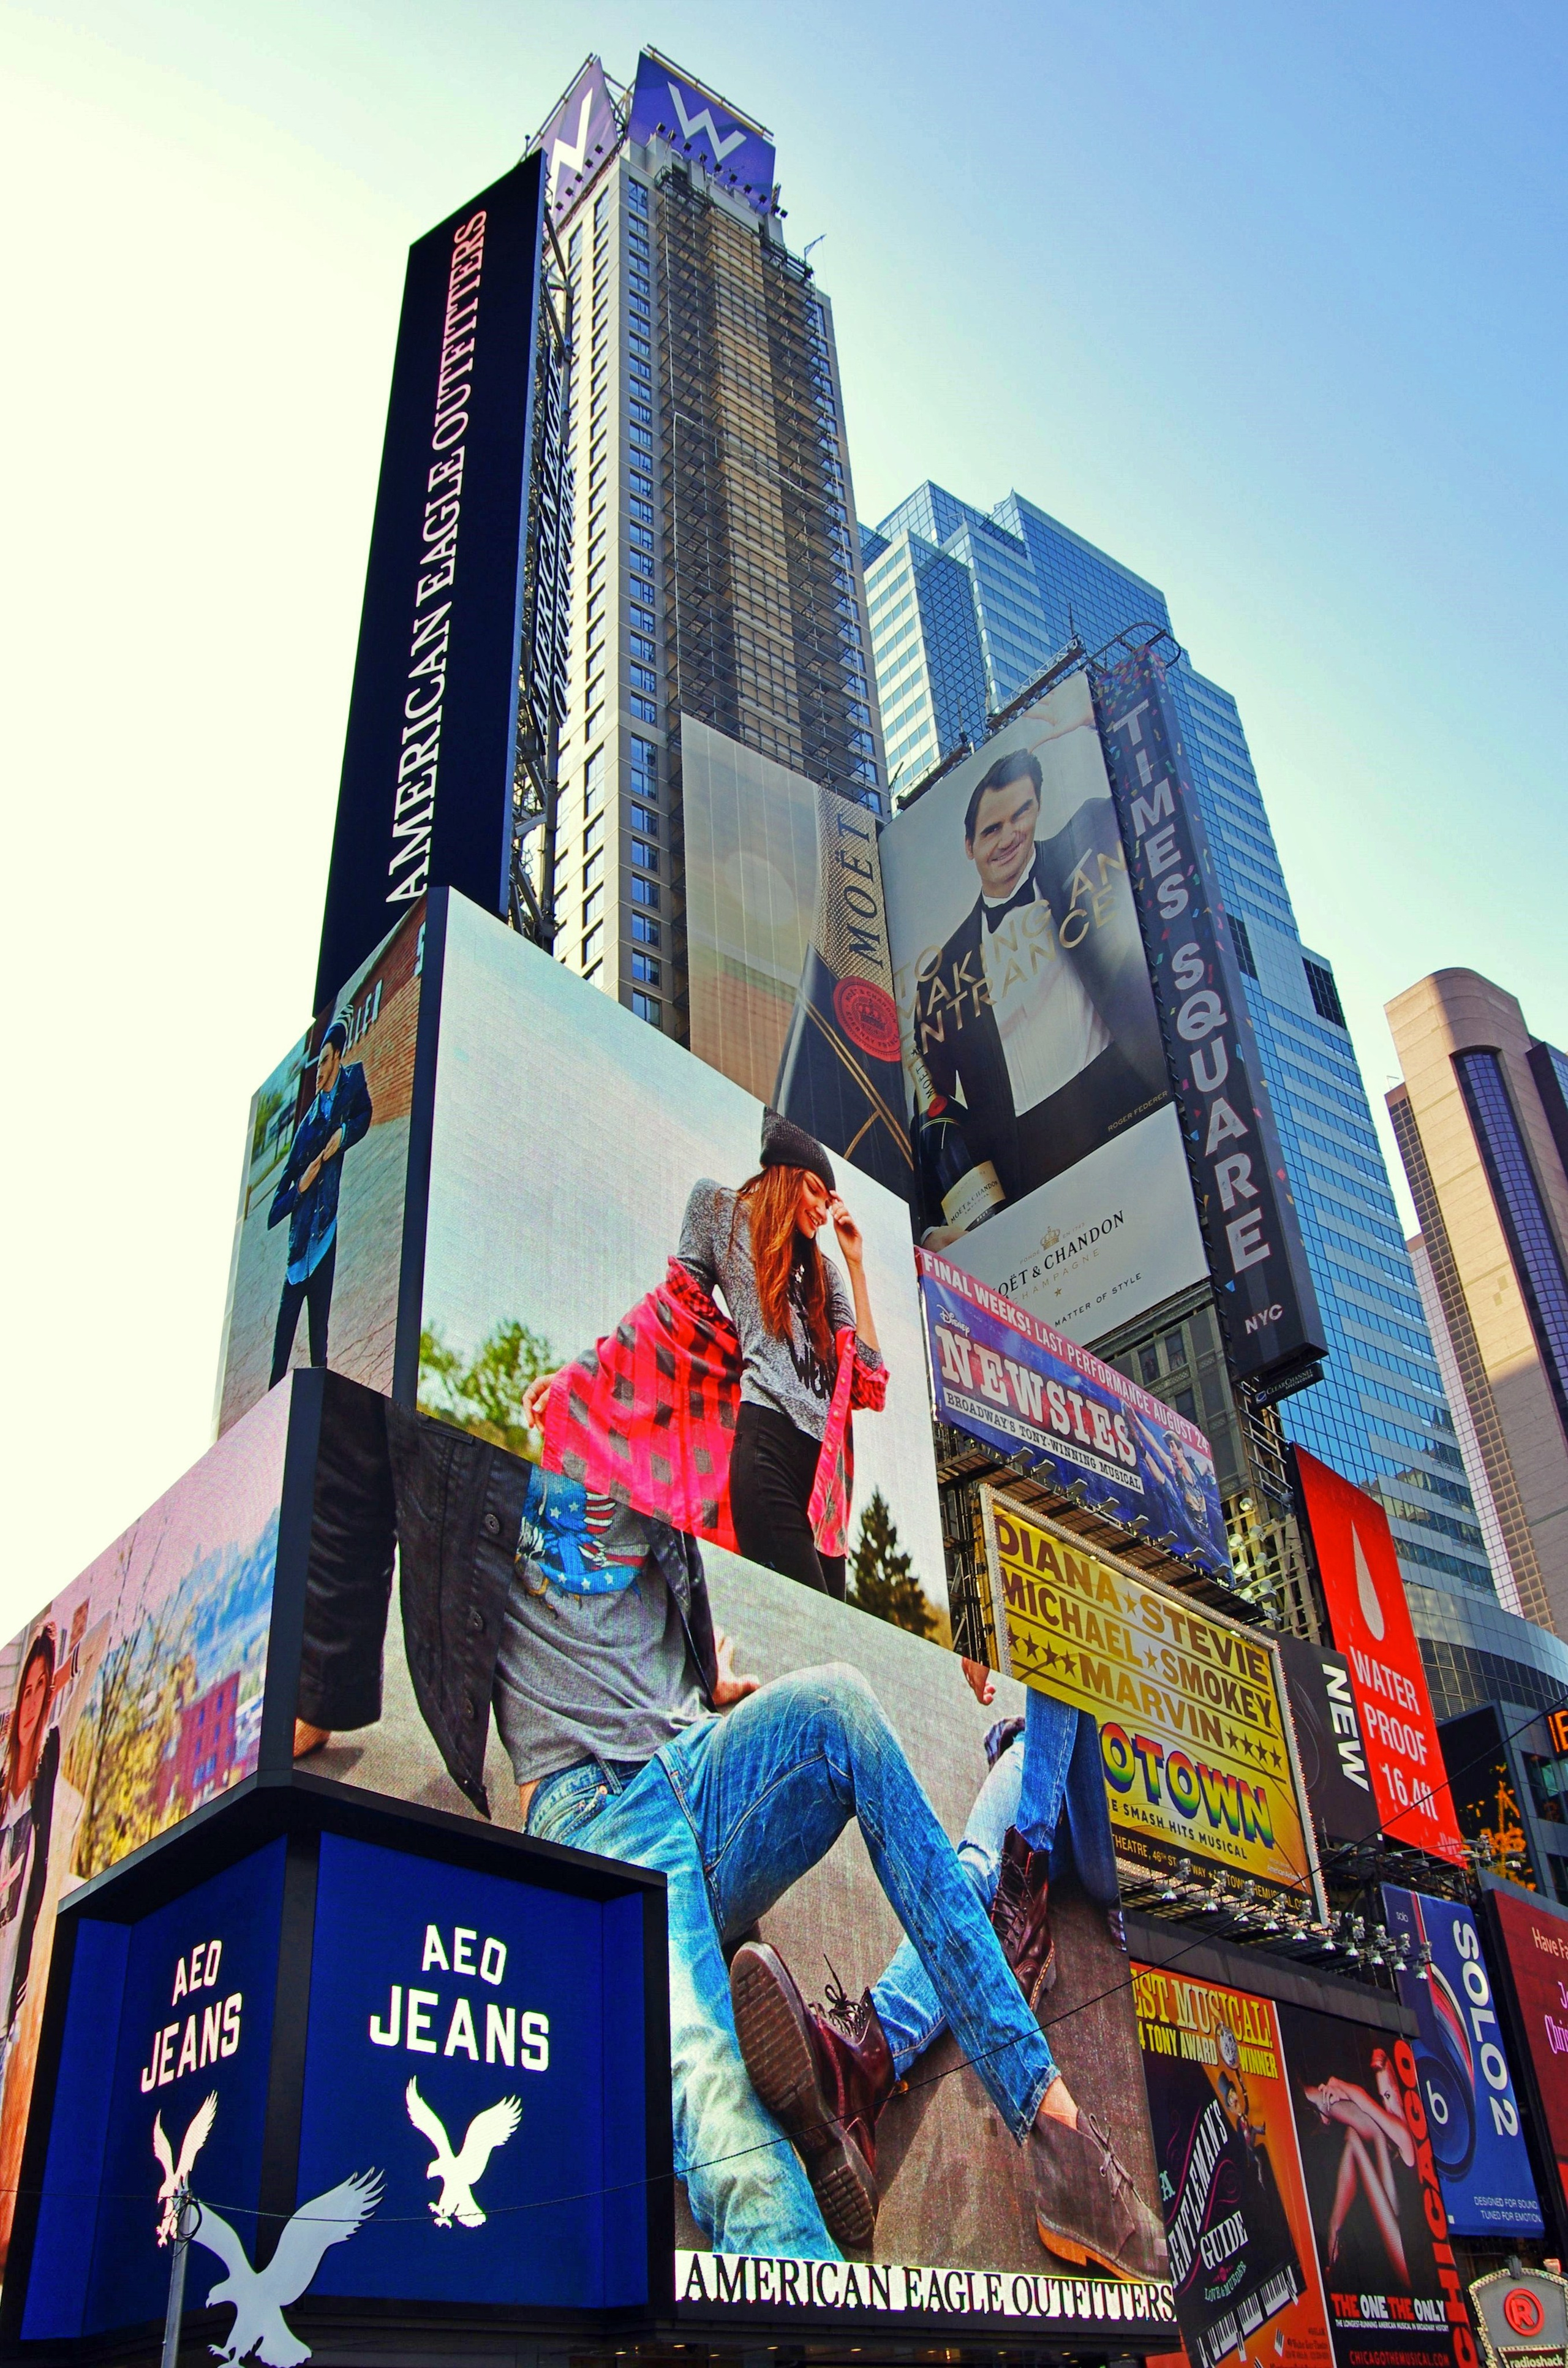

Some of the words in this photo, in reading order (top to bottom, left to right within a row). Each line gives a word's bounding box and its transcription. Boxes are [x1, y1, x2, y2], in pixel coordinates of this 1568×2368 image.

[667, 81, 747, 162] W
[431, 210, 487, 451] OUTFITTERS
[415, 445, 466, 608] EAGLE
[385, 601, 452, 904] AMERICAN
[837, 813, 884, 969] MOËT
[1069, 840, 1127, 910] AN
[892, 944, 943, 999] TO
[1113, 698, 1188, 920] TIMES
[1171, 942, 1271, 1274] SQUARE
[1107, 1112, 1133, 1132] ROGER
[1133, 1090, 1169, 1116] FEDERER
[993, 1268, 1028, 1299] OËT
[1032, 1265, 1042, 1279] &
[1044, 1209, 1125, 1270] CHANDON
[1054, 1302, 1091, 1328] MATTER
[1096, 1292, 1108, 1304] OF
[1111, 1273, 1142, 1295] STYLE
[1244, 1304, 1283, 1335] NYC
[922, 1253, 973, 1298] FINAL
[974, 1283, 1032, 1336] WEEKS!
[1034, 1322, 1063, 1356] LAST
[1066, 1345, 1152, 1415] PERFORMANCE
[1153, 1402, 1193, 1443] AUGUST
[1194, 1431, 1210, 1454] 24
[935, 1324, 1137, 1467] NEWSIES
[946, 1391, 1016, 1433] BROADWAY'S
[1019, 1424, 1098, 1470] TONY-WINNING
[1099, 1461, 1141, 1491] MUSICAL
[995, 1514, 1123, 1616] DIANA
[1140, 1593, 1269, 1687] STEVIE
[1001, 1567, 1144, 1669] MICHAEL
[1161, 1647, 1272, 1729] SMOKEY
[1349, 1644, 1420, 1715] WATER
[1078, 1652, 1225, 1749] MARVIN
[1321, 1663, 1370, 1792] NEW
[1363, 1701, 1428, 1766] PROOF
[1381, 1762, 1439, 1821] 16.4ft
[1123, 1804, 1165, 1829] SMASH
[1168, 1820, 1195, 1841] HITS
[1198, 1831, 1248, 1860] MUSICAL
[1396, 1912, 1409, 1923] solo
[1531, 1927, 1559, 1957] Have
[172, 1939, 224, 2007] AEO
[421, 1924, 508, 1986] AEO
[141, 1992, 244, 2094] JEANS
[368, 1984, 549, 2073] JEANS
[1171, 1978, 1274, 2049] MUSICAL!
[1453, 1919, 1509, 2091] SOLO
[1489, 2095, 1519, 2138] 2
[1146, 2023, 1178, 2057] TONY
[1180, 2030, 1219, 2067] AWARD
[1237, 2045, 1280, 2080] WINNER
[1161, 2170, 1176, 2202] A
[1393, 2039, 1477, 2368] CHICAGO
[1474, 2196, 1504, 2207] DESIGNED
[1504, 2198, 1518, 2208] FOR
[1480, 2209, 1501, 2221] TUNED
[1501, 2211, 1515, 2222] FOR
[1200, 2210, 1250, 2271] GUIDE
[684, 2252, 891, 2310] AMERICAN
[902, 2266, 1006, 2315] EAGLE
[1012, 2275, 1176, 2323] OUTFITTERS
[1204, 2286, 1221, 2302] LOVE
[1224, 2260, 1247, 2296] MURDER
[1330, 2292, 1361, 2318] THE
[1359, 2294, 1389, 2320] ONE
[1387, 2296, 1415, 2321] THE
[1414, 2298, 1447, 2323] ONLY
[1349, 2350, 1450, 2367] CHICAGOTHEMUSICAL.COM
[1509, 2353, 1564, 2368] radioshack
